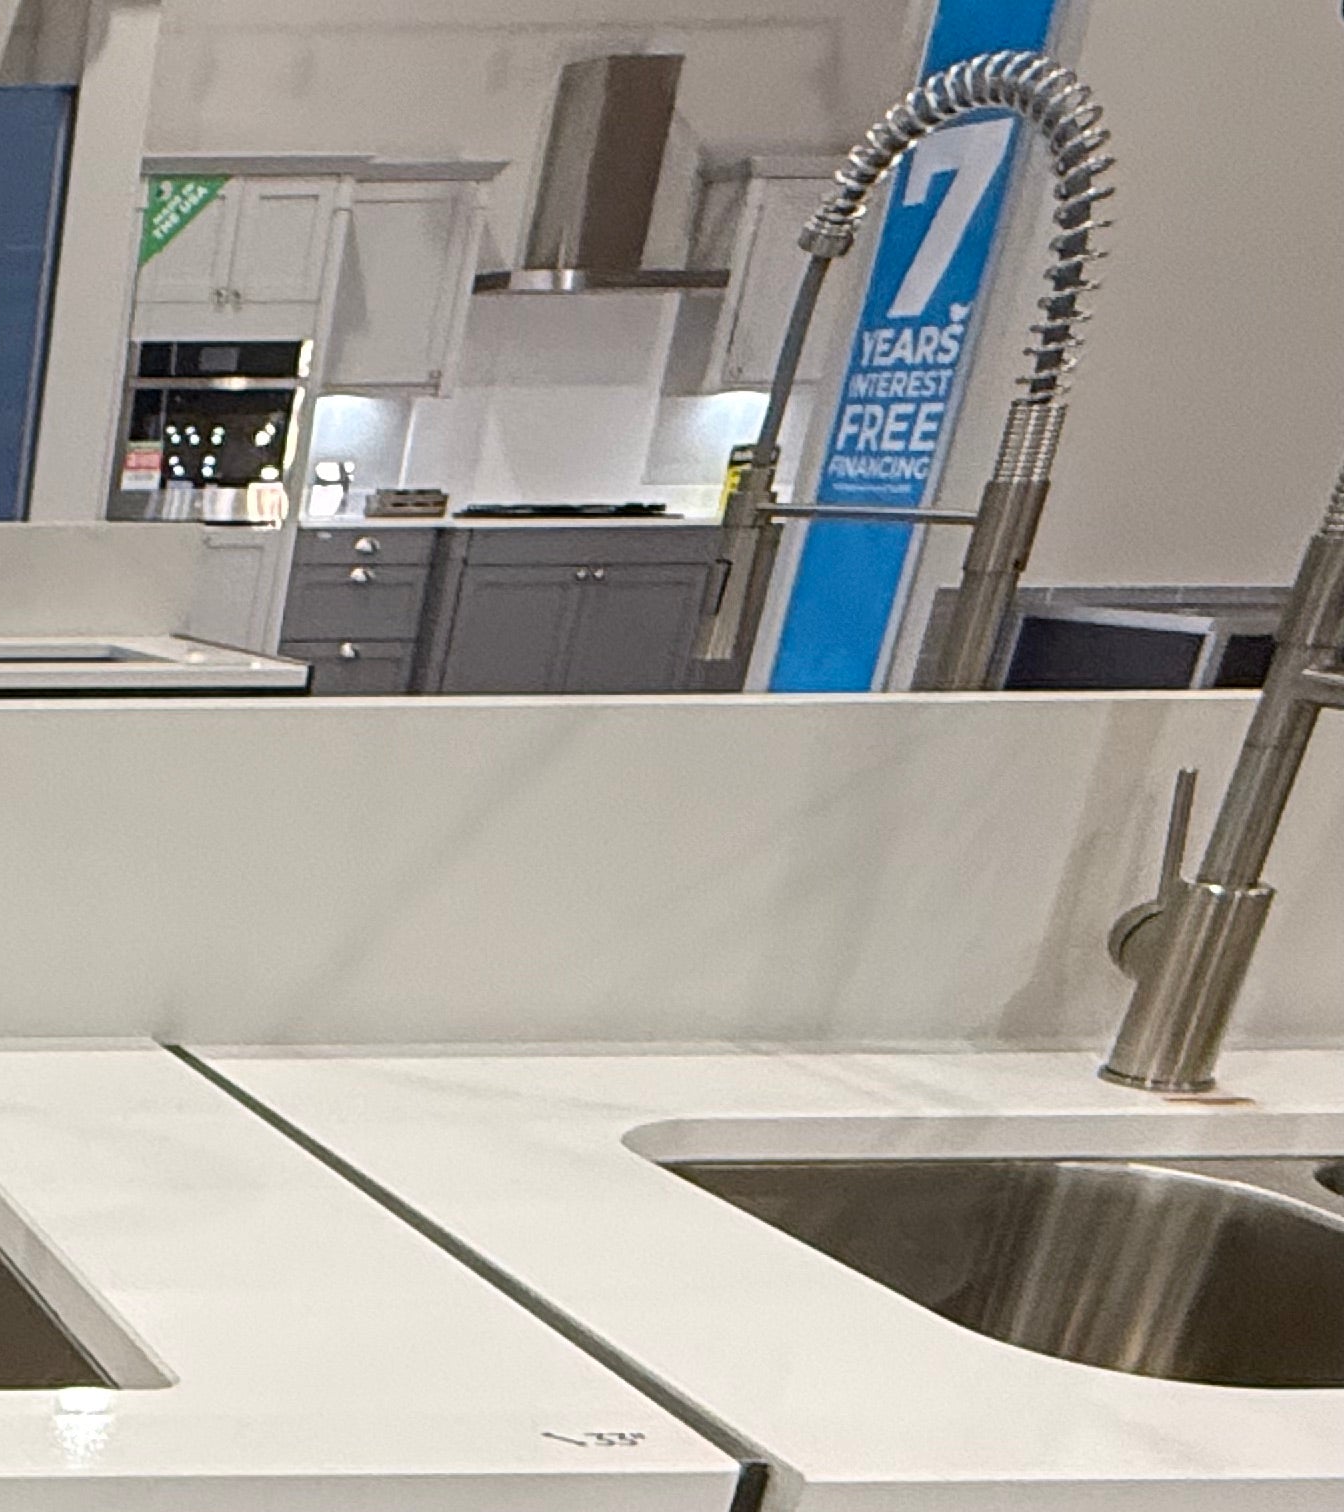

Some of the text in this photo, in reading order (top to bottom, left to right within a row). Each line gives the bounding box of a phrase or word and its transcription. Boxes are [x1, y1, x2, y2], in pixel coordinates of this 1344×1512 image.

[177, 184, 209, 215] USA
[886, 117, 1014, 319] 7
[848, 368, 954, 398] INTEREST
[836, 402, 946, 452] FREE
[827, 454, 931, 480] FINANCING
